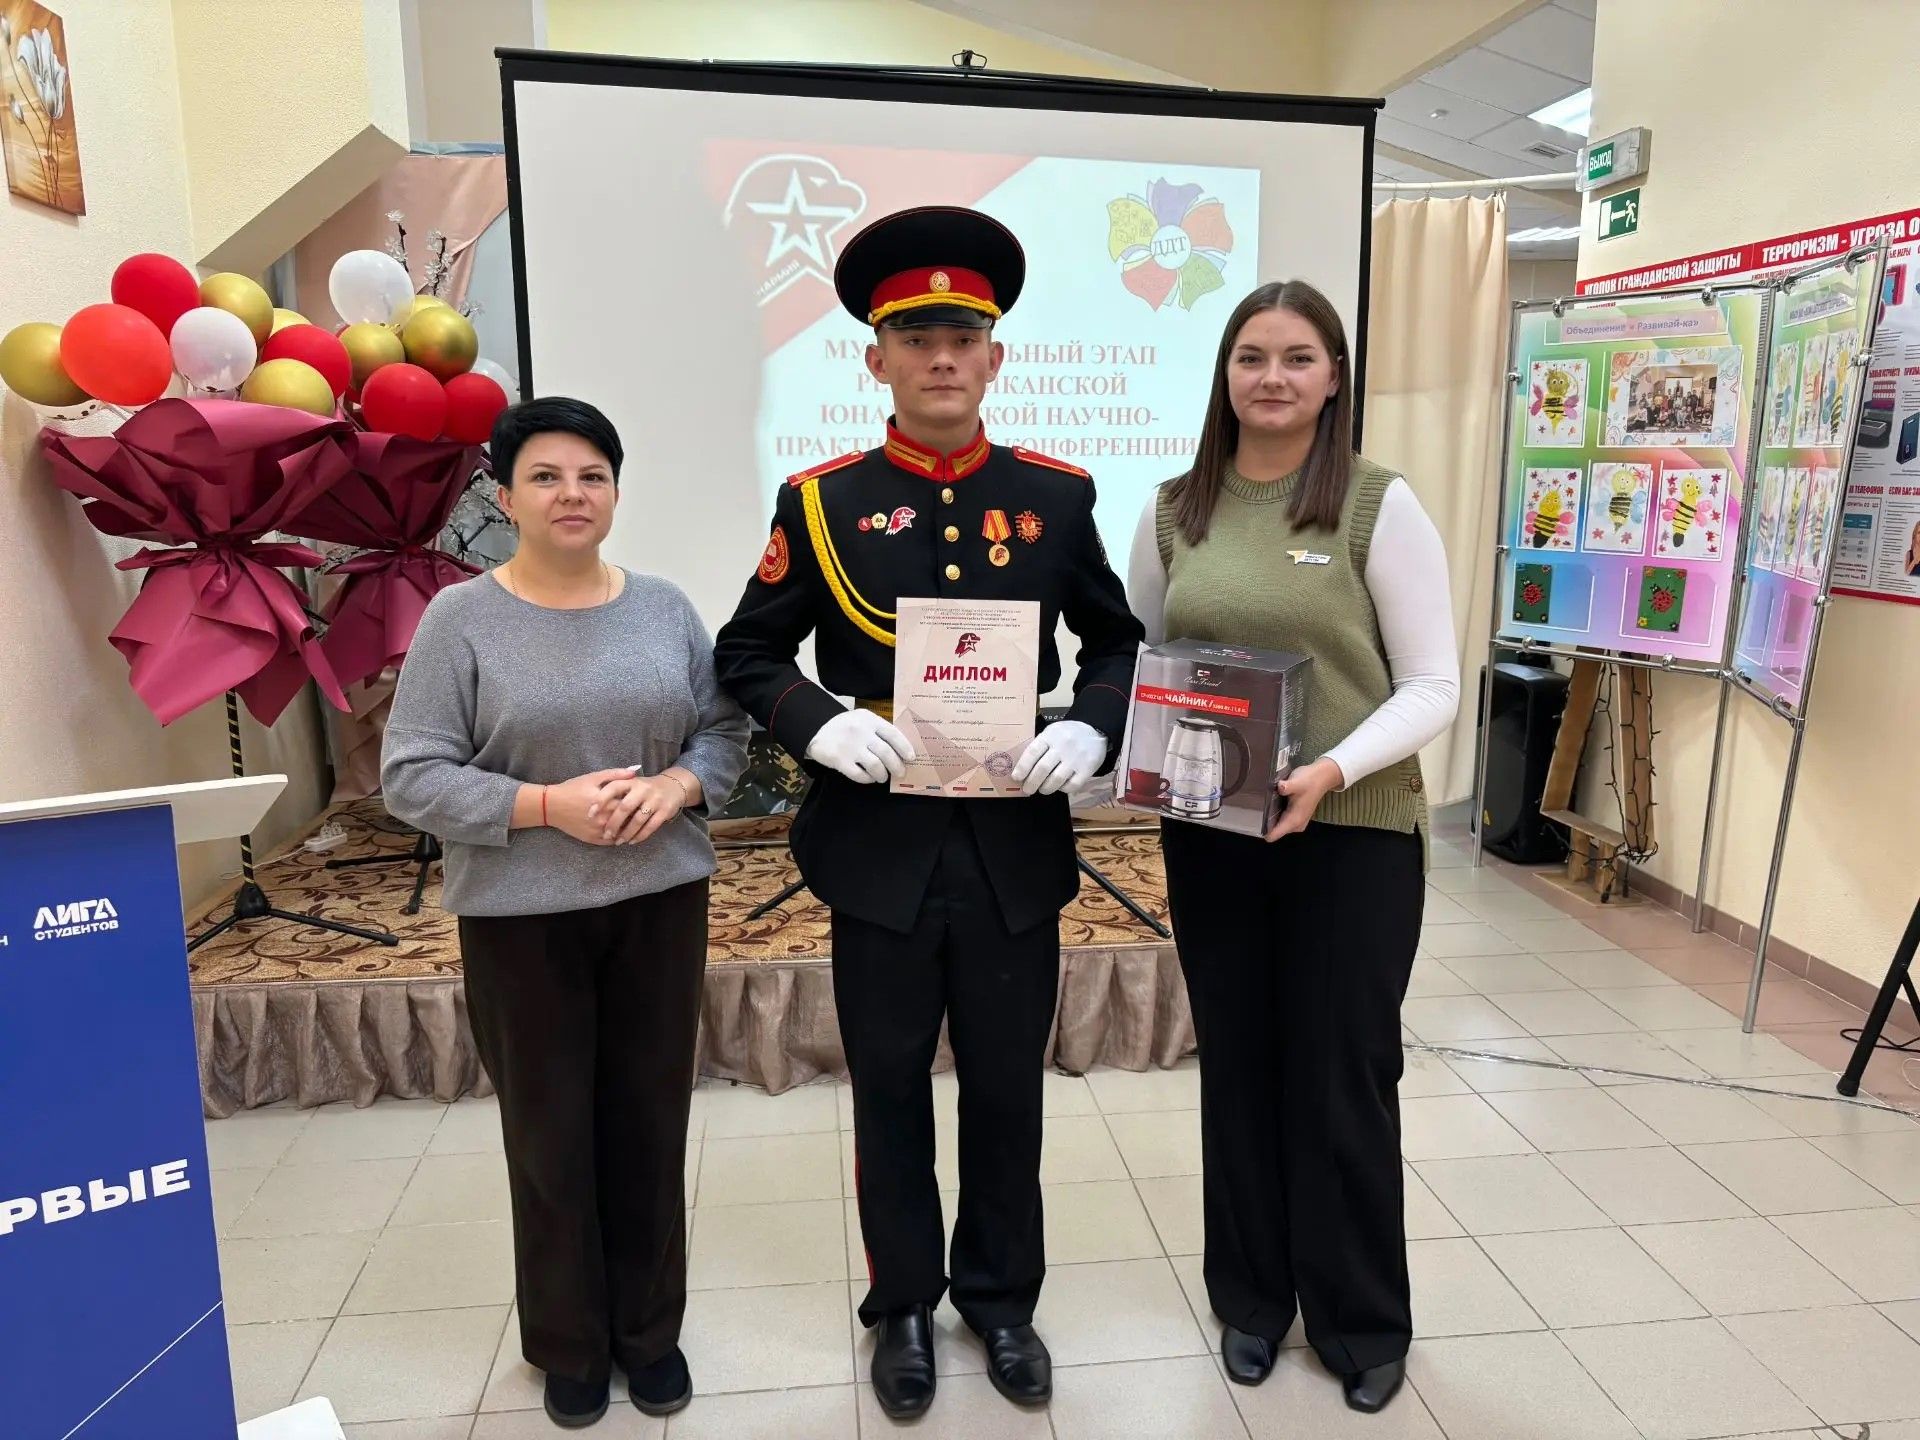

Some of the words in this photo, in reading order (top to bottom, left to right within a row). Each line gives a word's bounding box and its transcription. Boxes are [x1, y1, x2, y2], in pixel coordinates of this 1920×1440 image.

[1589, 149, 1612, 172] ВЫХОД
[1152, 236, 1187, 258] ДДТ
[1762, 233, 1840, 264] ТЕРРОРИЗМ
[1850, 219, 1905, 247] УГРОЗА
[1584, 280, 1617, 296] УГОЛОК
[1617, 260, 1690, 289] ГРАЖДАНСКОЙ
[1690, 251, 1742, 277] ЗАЩИТЫ
[1565, 322, 1626, 337] Объединение
[1090, 343, 1158, 366] ЭТАП
[1046, 406, 1160, 427] НАУЧНО-
[923, 665, 1007, 682] ДИПЛОМ
[1164, 693, 1208, 708] ЧАЙНИК
[33, 897, 118, 929] ЛИГА
[34, 920, 119, 941] СТУДЕНТОВ
